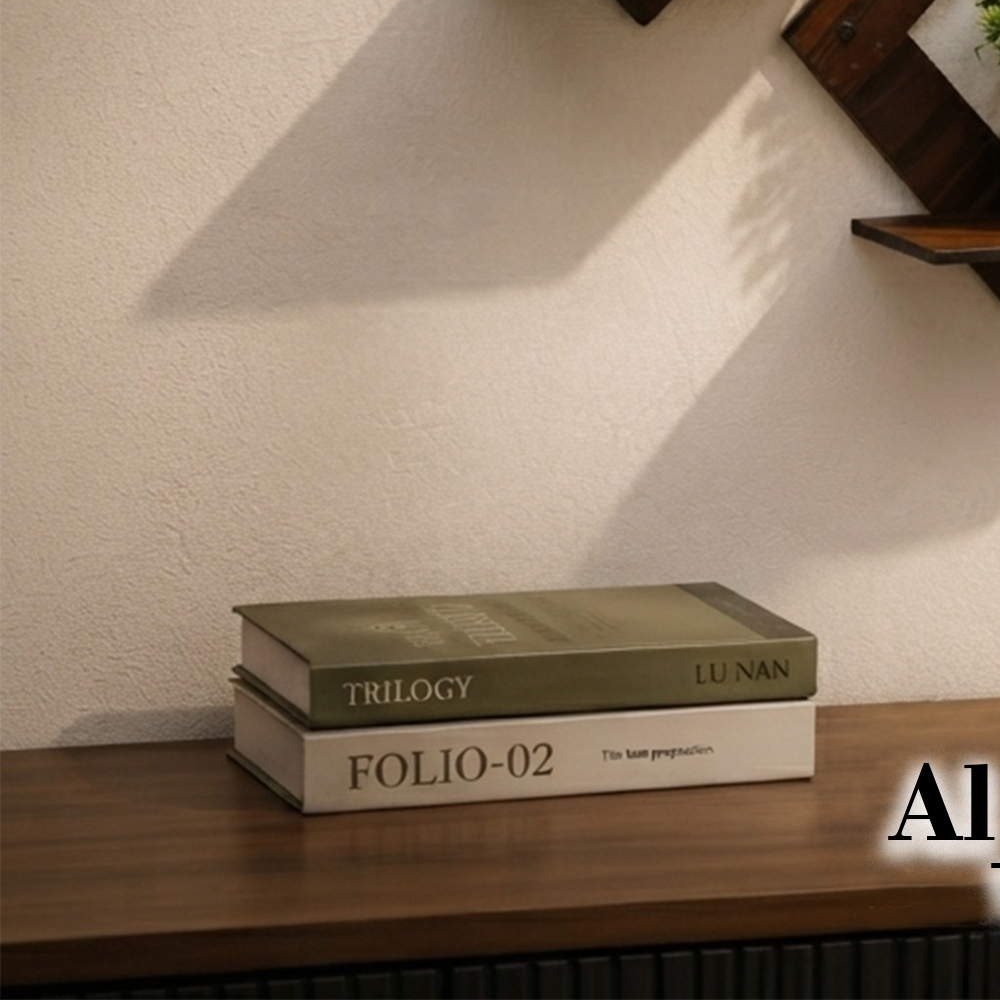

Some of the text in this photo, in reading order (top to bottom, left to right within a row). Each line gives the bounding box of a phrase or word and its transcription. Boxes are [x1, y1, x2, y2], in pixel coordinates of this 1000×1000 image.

[695, 659, 790, 685] LU NAN
[343, 675, 473, 706] TRILOGY
[347, 743, 554, 791] FOLIO-02
